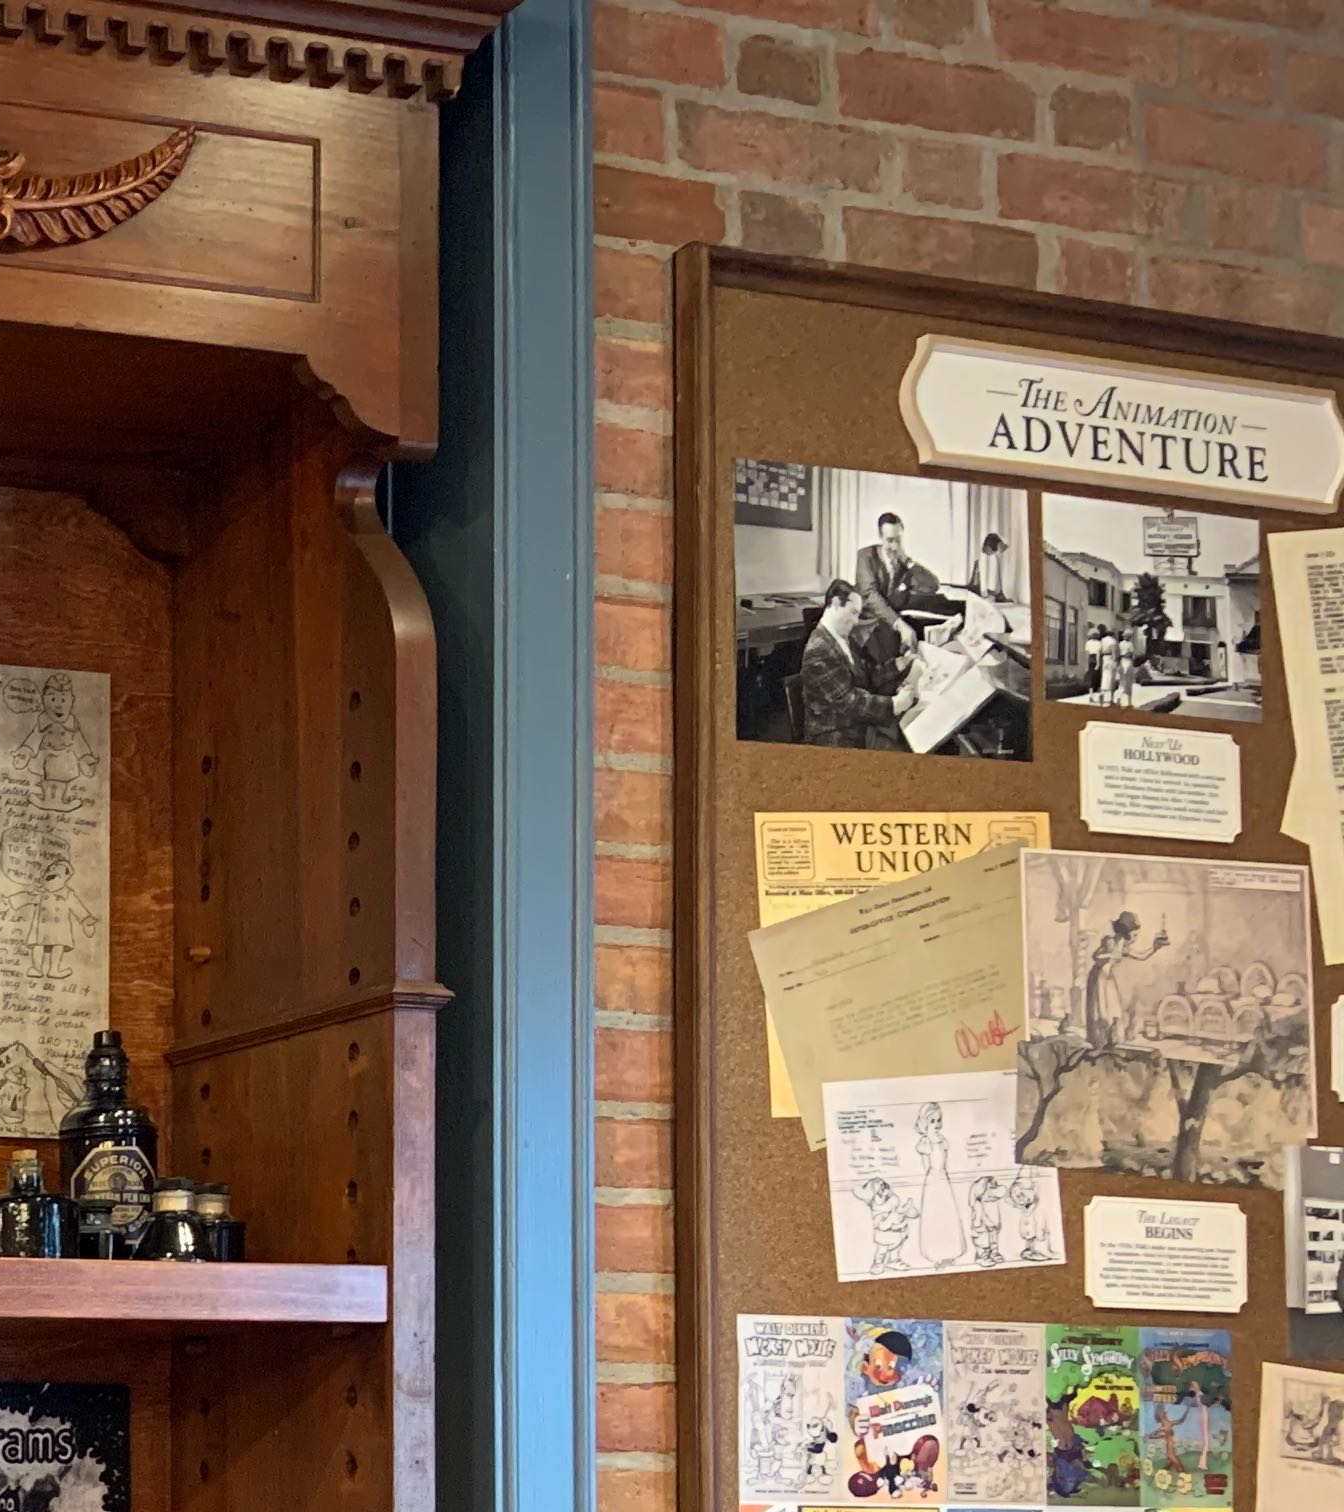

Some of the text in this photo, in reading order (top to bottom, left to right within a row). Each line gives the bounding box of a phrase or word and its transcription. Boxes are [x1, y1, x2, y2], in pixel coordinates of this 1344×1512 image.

[1017, 377, 1238, 437] THE ANIMATION
[988, 412, 1270, 483] ADVENTURE
[1123, 748, 1201, 766] HOLLYWOOD
[829, 822, 973, 846] WESTERN
[855, 850, 958, 873] UNION
[83, 1154, 148, 1182] SUPERIOR
[1144, 1226, 1194, 1241] BEGINS
[753, 1321, 784, 1336] WALT
[744, 1337, 837, 1359] MICKEY MOUSE
[1050, 1343, 1135, 1379] SILLY SYMPHONY
